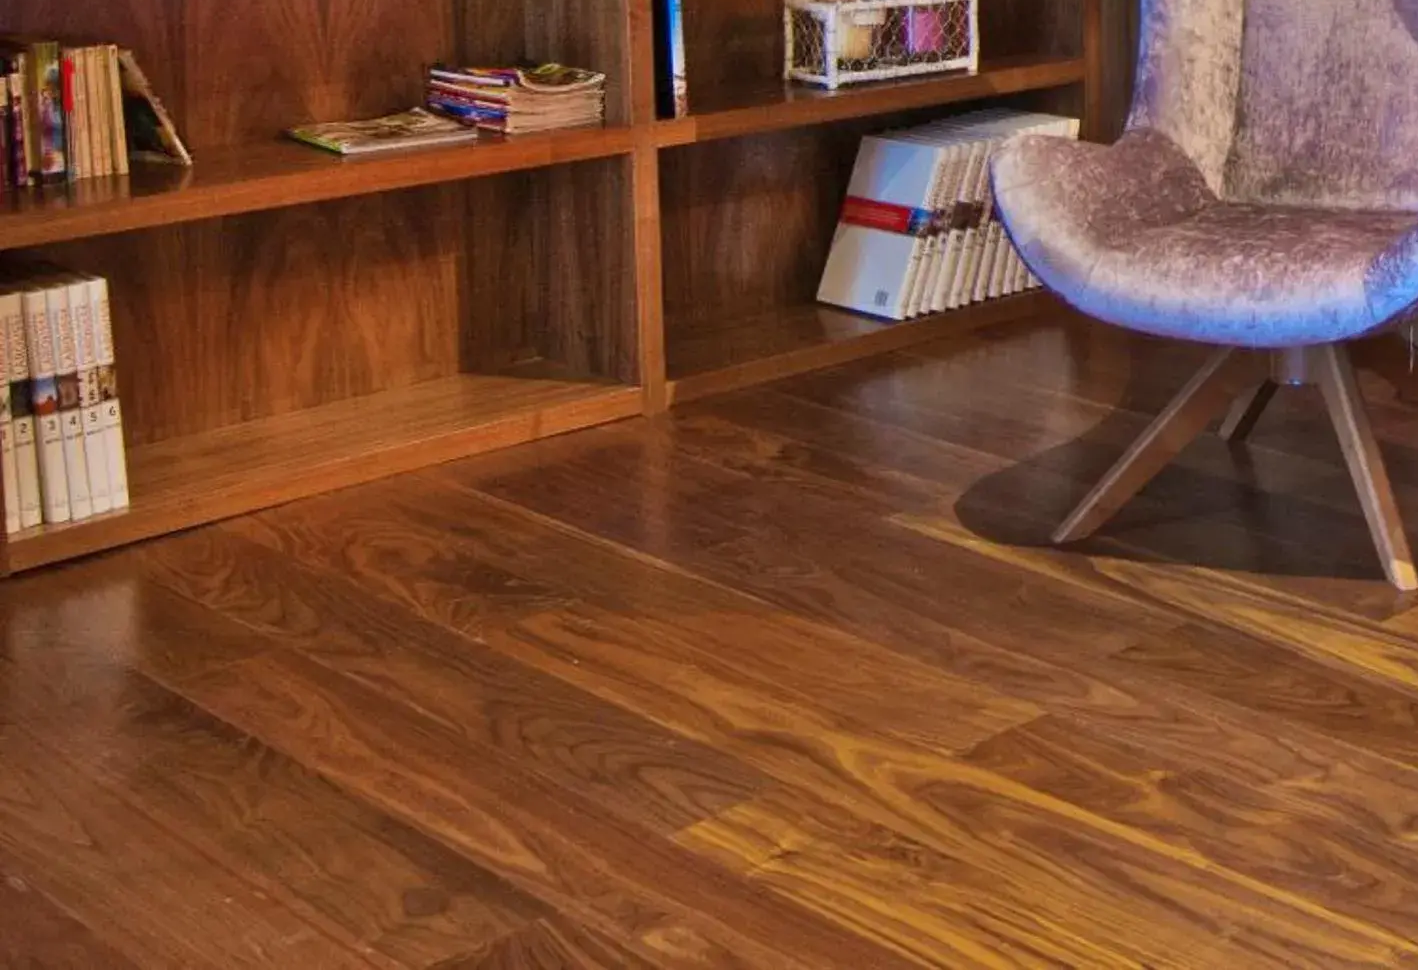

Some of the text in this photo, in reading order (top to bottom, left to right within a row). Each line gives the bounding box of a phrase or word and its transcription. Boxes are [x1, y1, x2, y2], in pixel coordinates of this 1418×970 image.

[109, 406, 116, 416] 6
[70, 416, 77, 426] 4
[90, 412, 98, 422] 5
[20, 423, 27, 433] 2
[48, 421, 56, 431] 3
